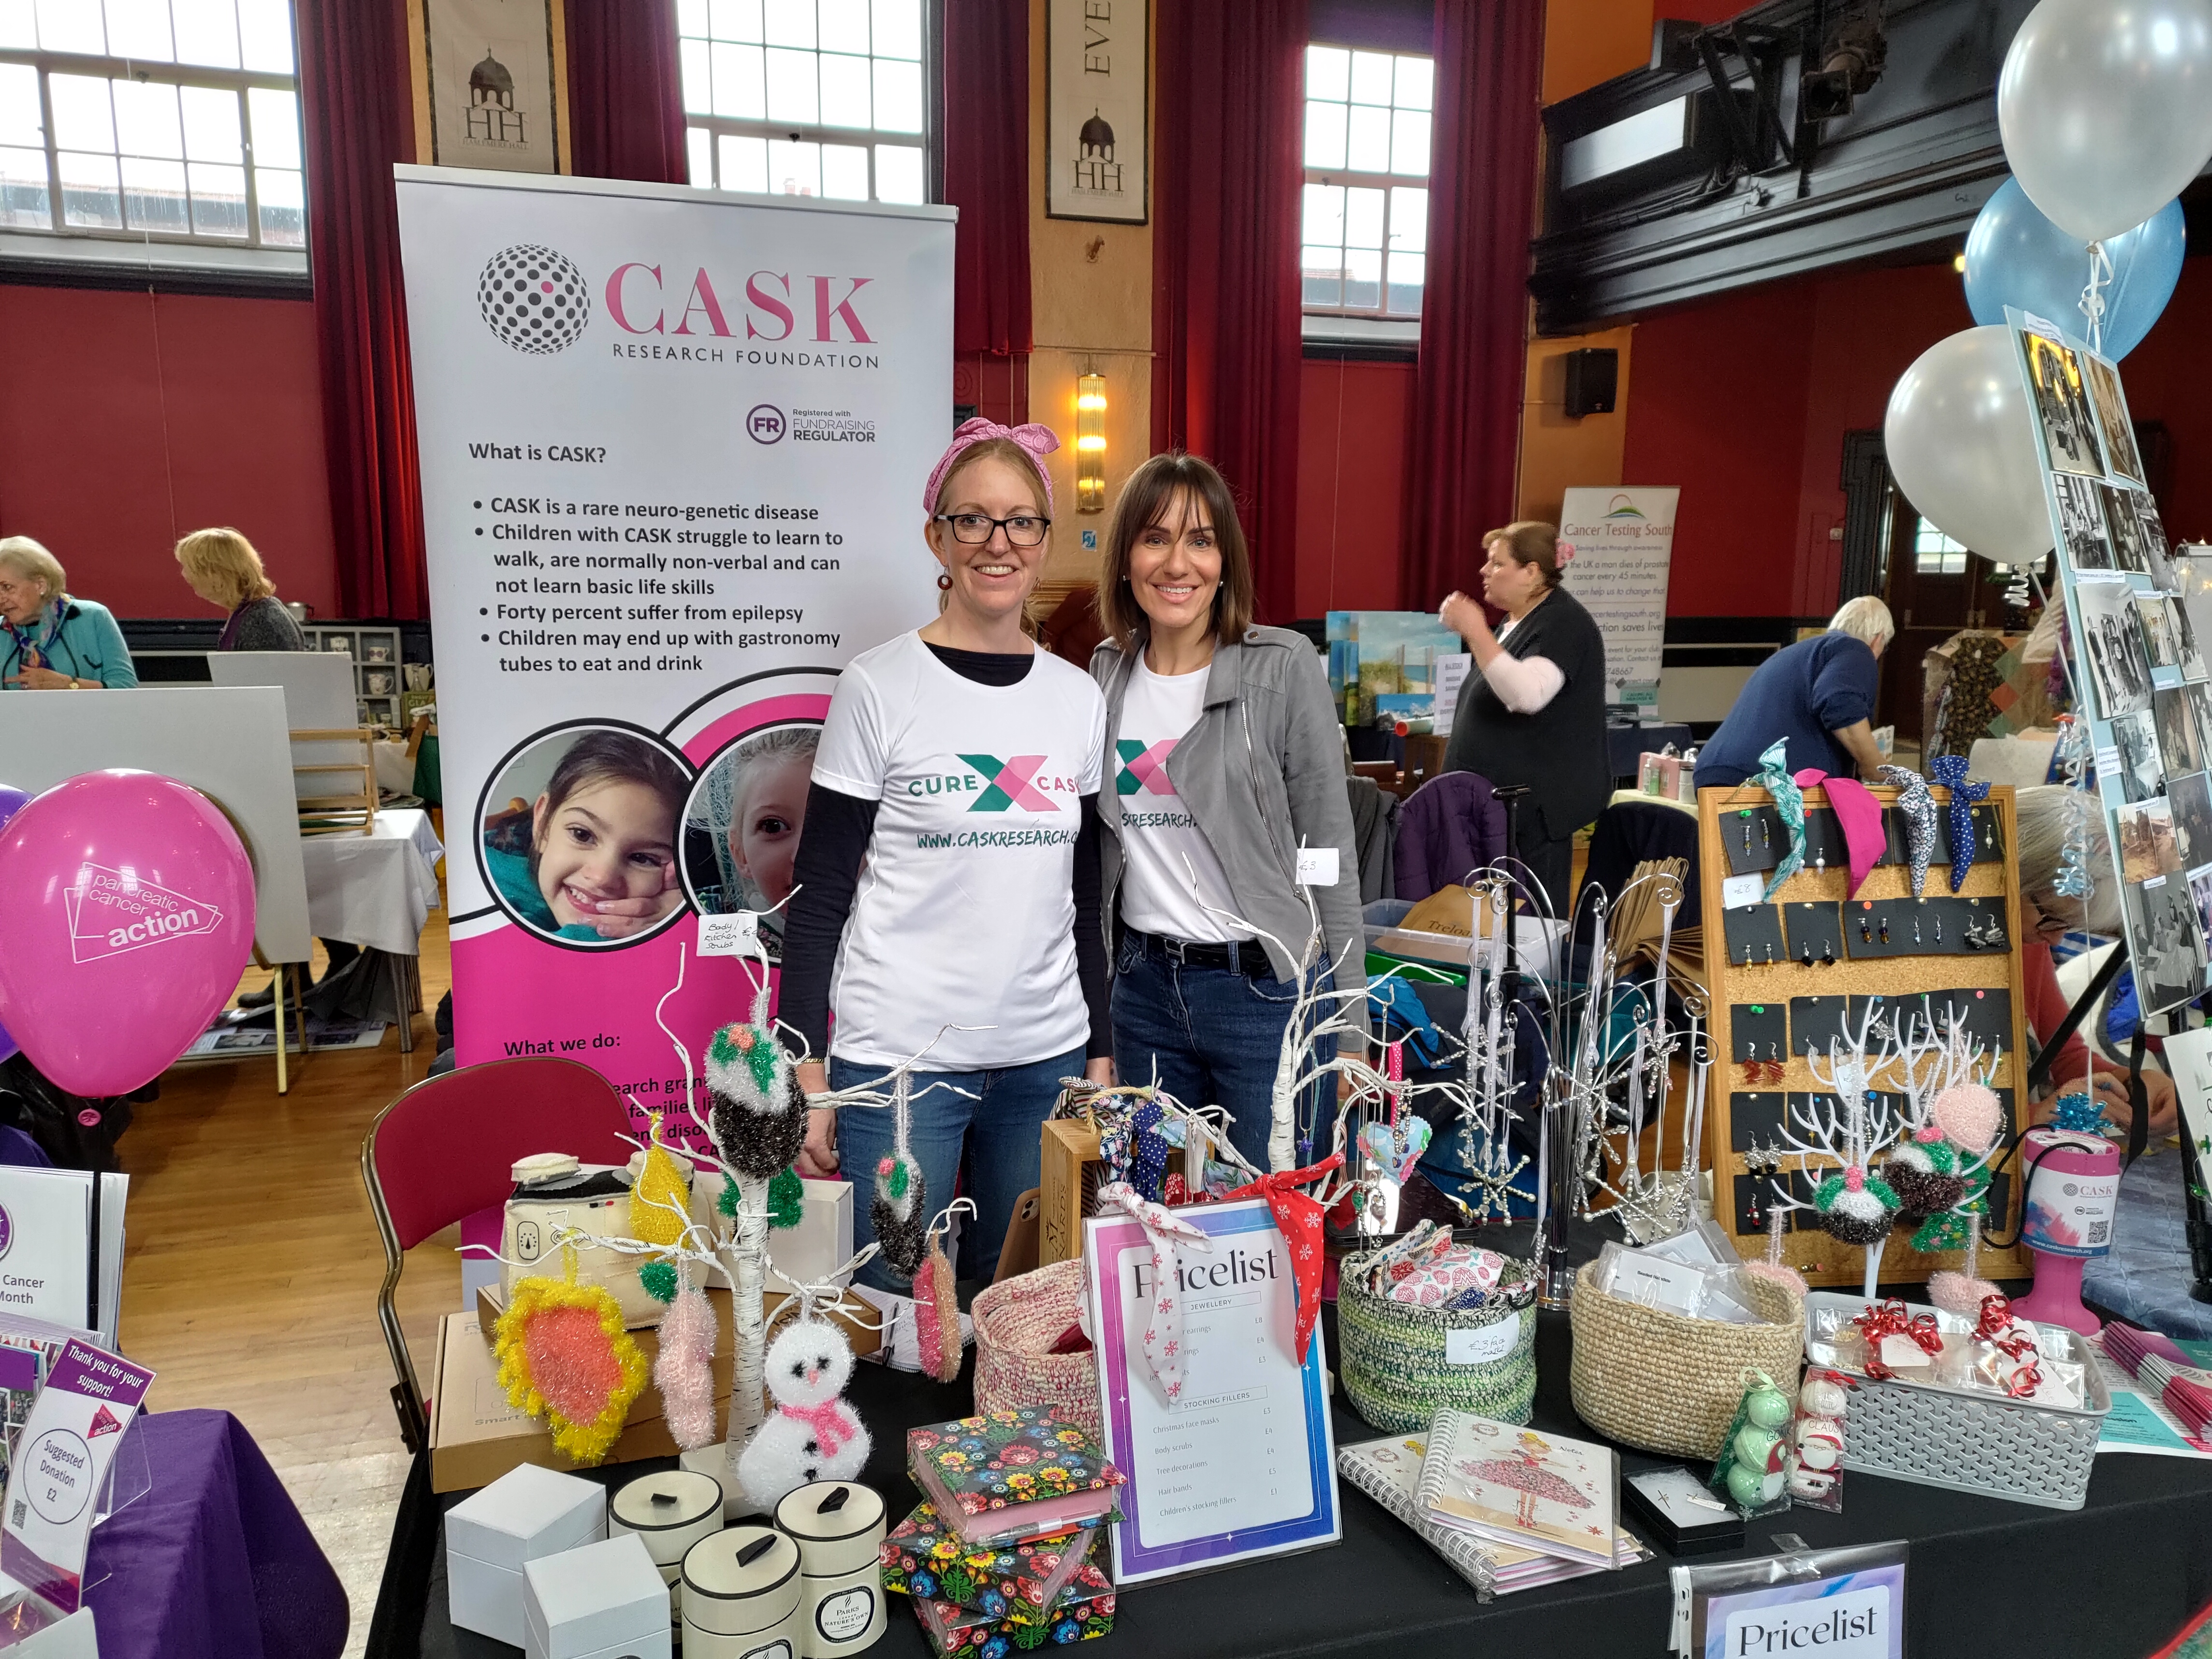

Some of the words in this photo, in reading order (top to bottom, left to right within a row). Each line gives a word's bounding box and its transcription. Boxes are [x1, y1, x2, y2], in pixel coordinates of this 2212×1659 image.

[605, 262, 878, 344] CASK
[612, 343, 724, 364] RESEARCH
[736, 350, 879, 369] FOUNDATION
[793, 409, 833, 417] Registered
[754, 417, 780, 433] FR
[793, 418, 875, 430] FUNDRAISING
[793, 429, 876, 442] REGULATOR
[469, 443, 522, 461] What
[527, 444, 542, 461] is
[547, 445, 607, 464] CASK?
[491, 497, 541, 515] CASK
[546, 498, 561, 515] is
[566, 503, 576, 516] a
[582, 503, 619, 517] rare
[625, 502, 749, 521] neuro-genetic
[755, 504, 819, 521] disease
[493, 524, 571, 542] Children
[577, 525, 619, 543] with
[624, 527, 672, 544] CASK
[676, 529, 747, 548] struggle
[753, 531, 770, 546] to
[776, 530, 820, 546] learn
[825, 531, 843, 547] to
[1564, 523, 1601, 536] Cancer
[1605, 524, 1642, 538] Testing
[1645, 524, 1673, 536] South
[494, 551, 545, 570] walk,
[550, 555, 580, 568] are
[585, 553, 667, 572] normally
[672, 553, 768, 570] non-verbal
[773, 554, 806, 571] and
[810, 558, 841, 571] can
[1571, 559, 1582, 568] the
[1583, 560, 1594, 568] UK
[1619, 559, 1634, 568] dies
[1635, 557, 1643, 568] of
[1597, 574, 1616, 582] every
[1619, 571, 1629, 580] 45
[495, 578, 528, 594] not
[534, 577, 581, 594] learn
[587, 578, 633, 595] basic
[638, 578, 667, 595] life
[671, 579, 715, 596] skills
[1590, 586, 1605, 597] help
[1617, 587, 1624, 596] to
[1625, 587, 1651, 598] change
[497, 604, 546, 624] Forty
[552, 605, 623, 624] percent
[628, 604, 679, 622] suffer
[684, 604, 727, 622] from
[732, 605, 803, 624] epilepsy
[1622, 624, 1645, 632] saves
[498, 629, 577, 647] Children
[582, 633, 622, 650] may
[626, 629, 661, 647] end
[666, 633, 689, 650] up
[694, 629, 733, 646] with
[738, 632, 841, 650] gastronomy
[499, 655, 552, 673] tubes
[557, 658, 577, 673] to
[582, 657, 612, 672] eat
[617, 655, 651, 672] and
[656, 655, 703, 672] drink
[908, 774, 978, 798] CURE
[89, 888, 148, 915] cancer
[92, 874, 179, 913] pancreatic
[108, 909, 199, 947] action
[503, 1039, 555, 1057] What
[560, 1038, 587, 1052] we
[592, 1033, 621, 1049] do:
[2080, 1185, 2113, 1196] CASK
[3, 1274, 44, 1288] Cancer
[1132, 1248, 1279, 1299] Picelist
[1190, 1297, 1232, 1311] JEWELLERY
[1187, 1325, 1211, 1336] earrings
[68, 1344, 93, 1366] Thank
[92, 1357, 109, 1375] you
[108, 1364, 124, 1378] for
[122, 1370, 144, 1388] your
[77, 1373, 114, 1398] support!
[1184, 1395, 1220, 1410] STOCKING
[1222, 1391, 1251, 1405] FILLERS
[475, 1414, 520, 1426] Smart
[1152, 1422, 1184, 1435] Christmas
[1185, 1420, 1200, 1430] face
[1200, 1416, 1220, 1427] masks
[1808, 1420, 1839, 1433] CLAUS
[94, 1423, 117, 1436] action
[43, 1439, 85, 1470] Suggested
[1154, 1444, 1171, 1455] Body
[1172, 1441, 1193, 1453] scrubs
[39, 1459, 75, 1489] Donation
[1156, 1465, 1170, 1475] Tree
[1171, 1460, 1208, 1473] decorations
[46, 1486, 57, 1502] £2
[1158, 1486, 1172, 1497] Hair
[1173, 1482, 1193, 1494] bands
[1159, 1504, 1191, 1518] Children's
[1192, 1499, 1218, 1514] stocking
[1219, 1496, 1237, 1508] fillers
[837, 1606, 859, 1616] PARKS
[856, 1611, 869, 1620] OWN
[1738, 1606, 1877, 1659] Pricelist
